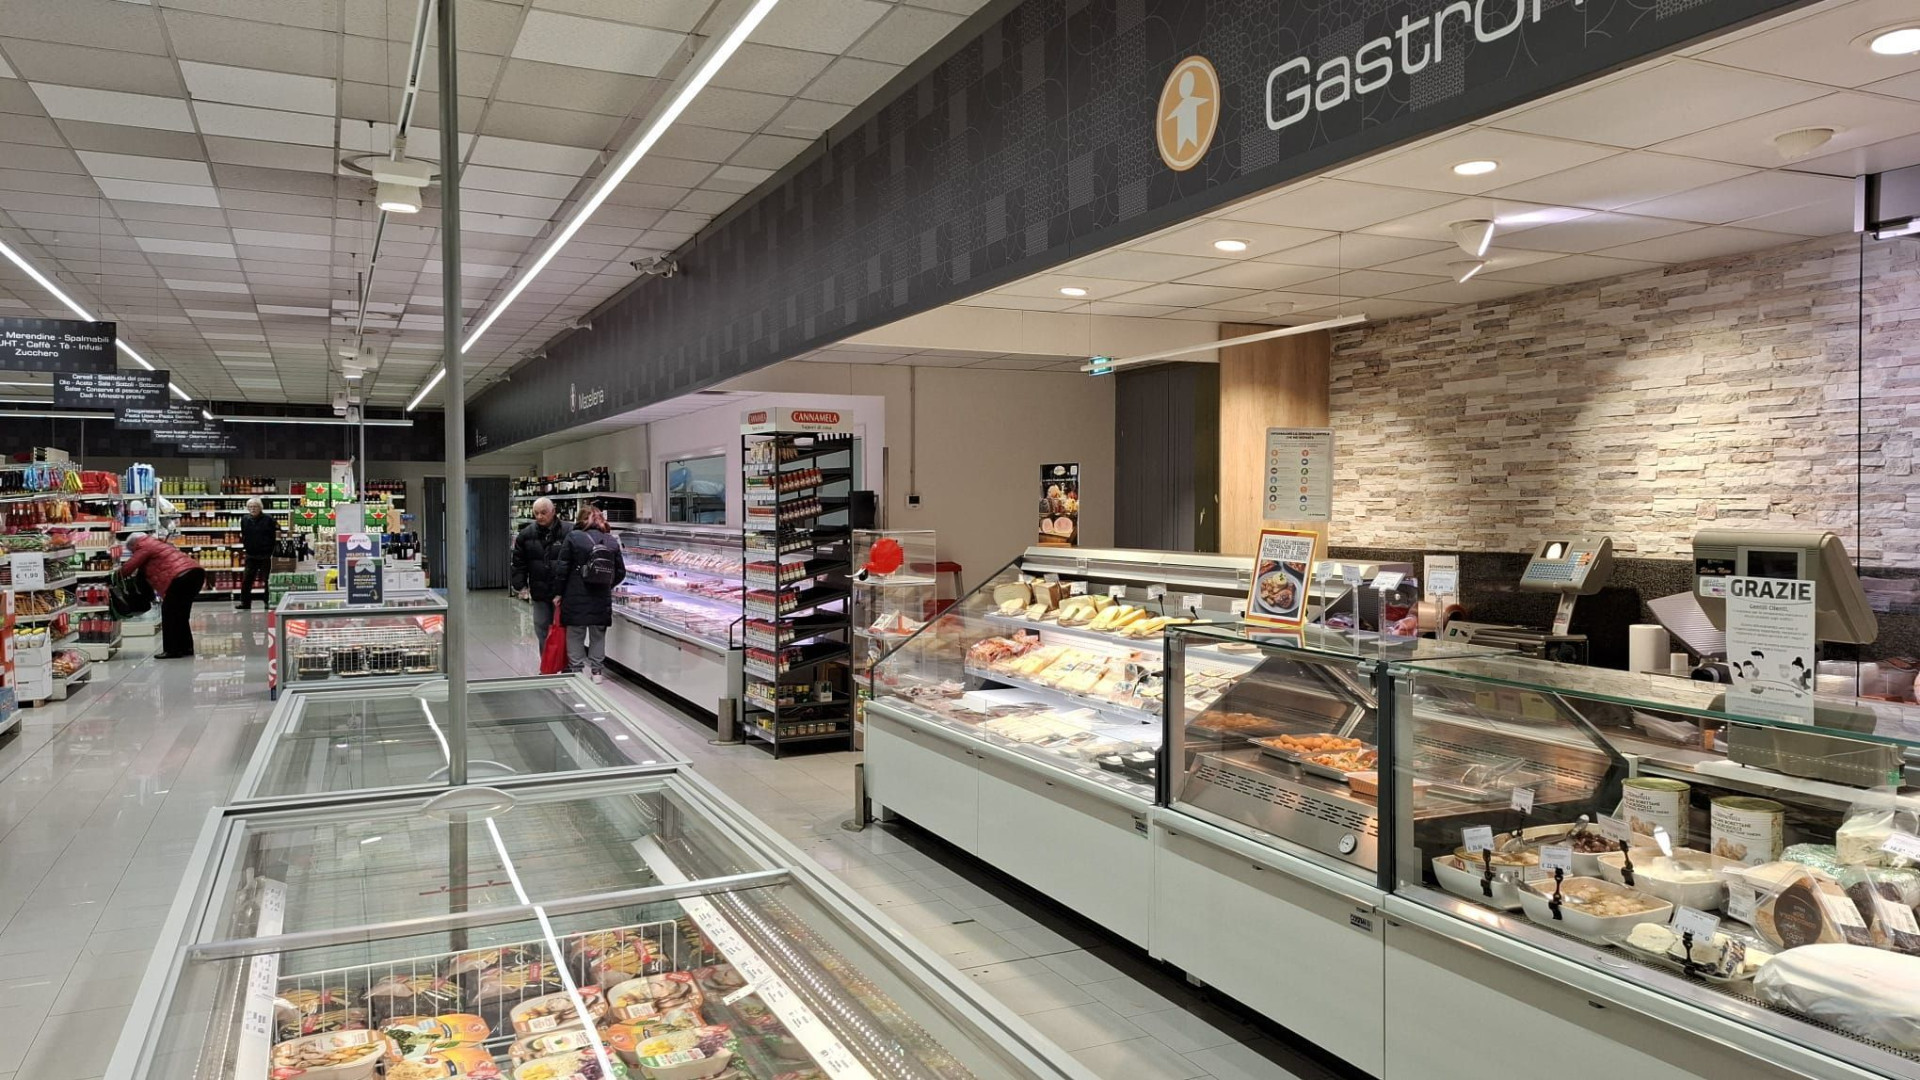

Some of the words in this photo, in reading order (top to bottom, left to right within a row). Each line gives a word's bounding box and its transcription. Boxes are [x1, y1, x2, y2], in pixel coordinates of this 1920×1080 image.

[1265, 0, 1583, 131] Gastro
[5, 331, 56, 341] Merendine
[64, 334, 110, 343] Spalmabili
[26, 340, 51, 349] Caffè
[79, 343, 103, 351] Infusi
[15, 348, 59, 357] Zucchero
[578, 386, 604, 410] Macelleria
[792, 412, 838, 423] CANNAMELA
[1730, 578, 1812, 601] GRAZIE
